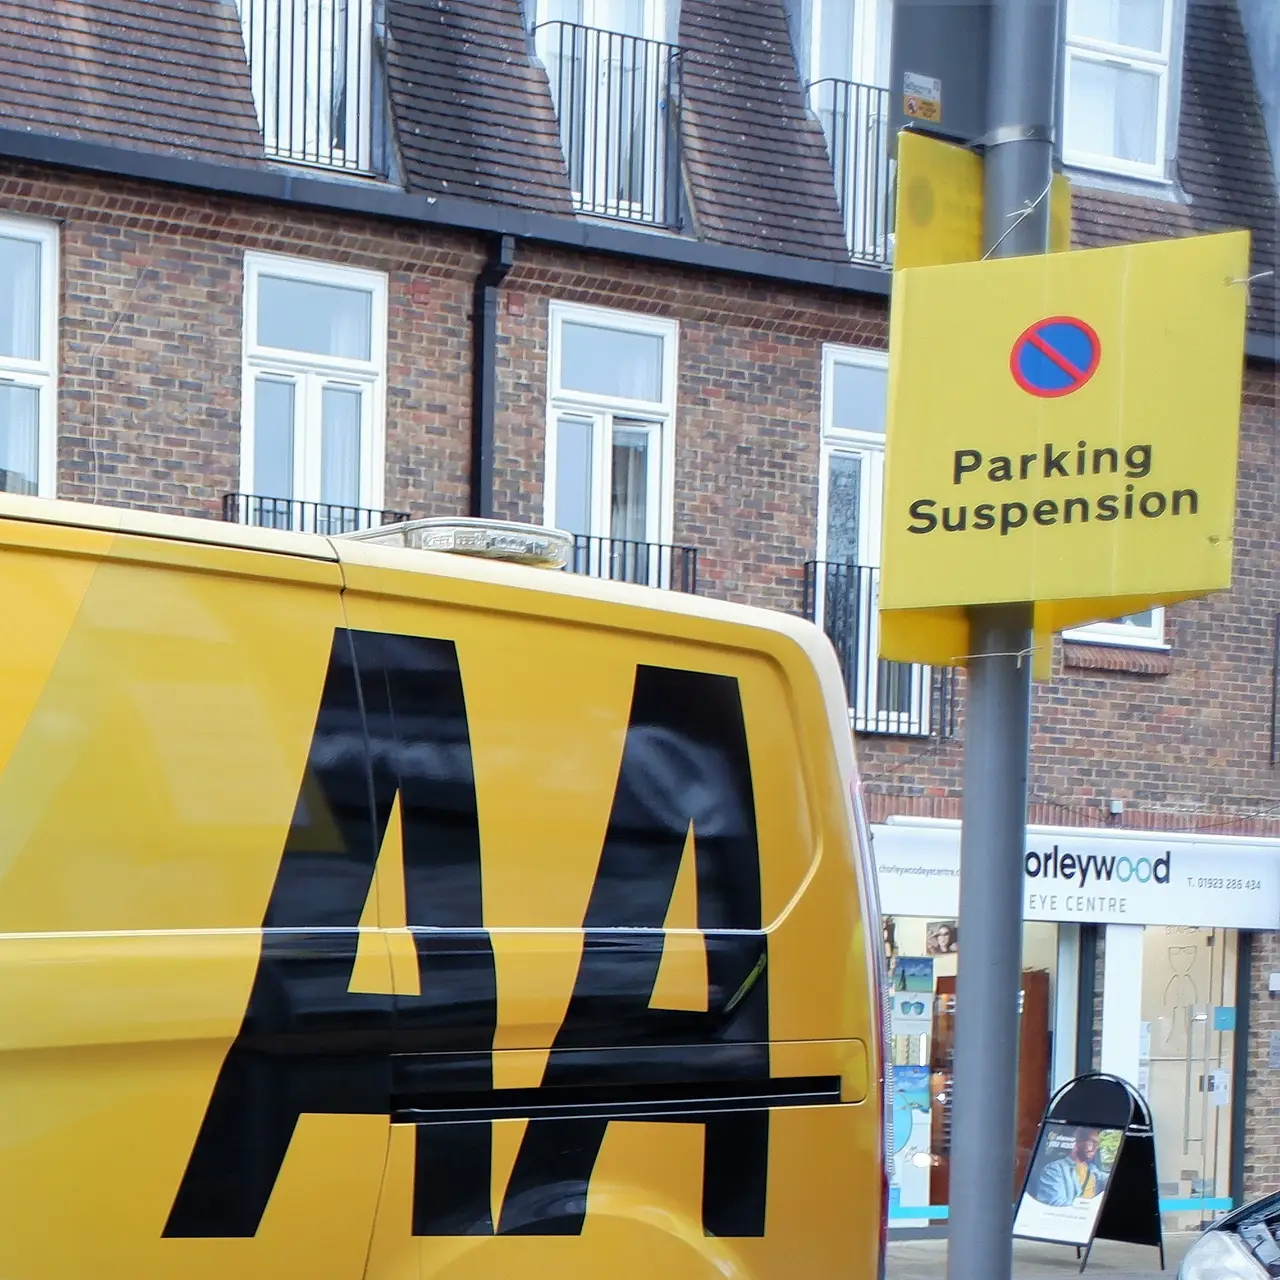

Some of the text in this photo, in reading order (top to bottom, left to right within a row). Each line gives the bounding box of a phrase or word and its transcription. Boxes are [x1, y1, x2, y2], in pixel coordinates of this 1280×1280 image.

[953, 441, 1153, 485] Parking
[907, 484, 1199, 535] Suspension
[1025, 845, 1171, 888] orleywood
[1028, 894, 1128, 914] EYE CENTRE
[161, 627, 771, 1239] AA
